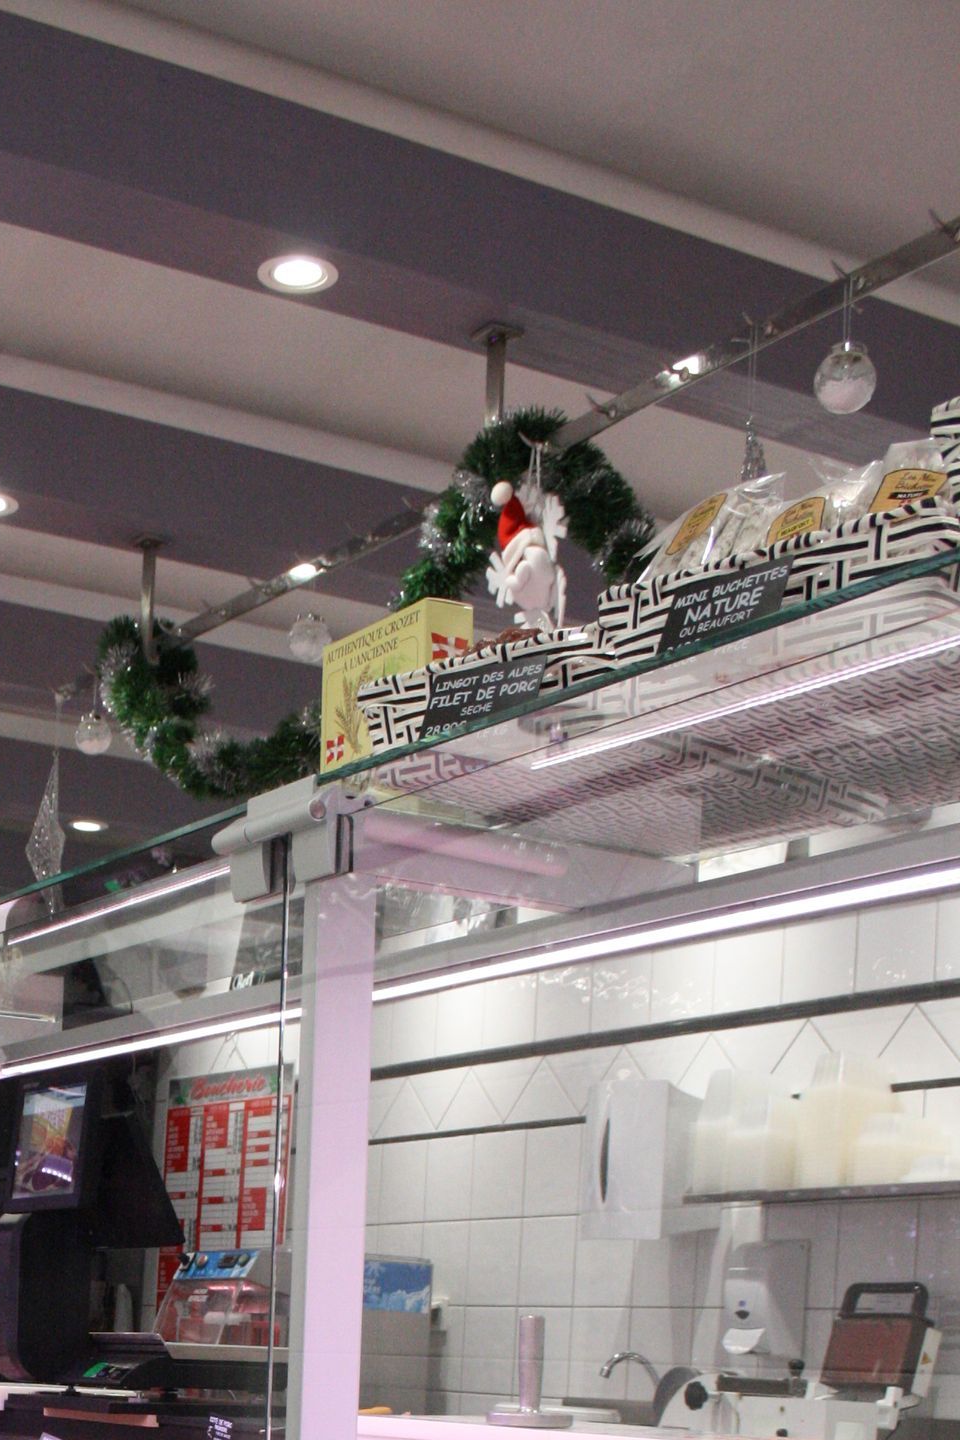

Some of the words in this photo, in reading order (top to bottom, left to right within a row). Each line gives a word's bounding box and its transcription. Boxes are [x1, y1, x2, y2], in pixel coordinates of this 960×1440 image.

[674, 589, 709, 610] MINI
[712, 565, 788, 598] BUCHETTES
[684, 586, 764, 626] NATURE
[326, 627, 382, 665] AUTHENTIQUE
[384, 610, 420, 637] CROZET
[679, 626, 695, 638] OU
[697, 609, 754, 634] BEAUFORT
[349, 637, 399, 669] L'ANCIENNE
[429, 691, 472, 710] FILET
[475, 686, 496, 701] DE
[499, 678, 539, 697] PORC
[435, 676, 479, 693] LINGOT
[482, 670, 504, 684] DES
[508, 664, 542, 678] ALPES
[460, 702, 493, 717] SECHE
[191, 1071, 266, 1100] Boucherie
